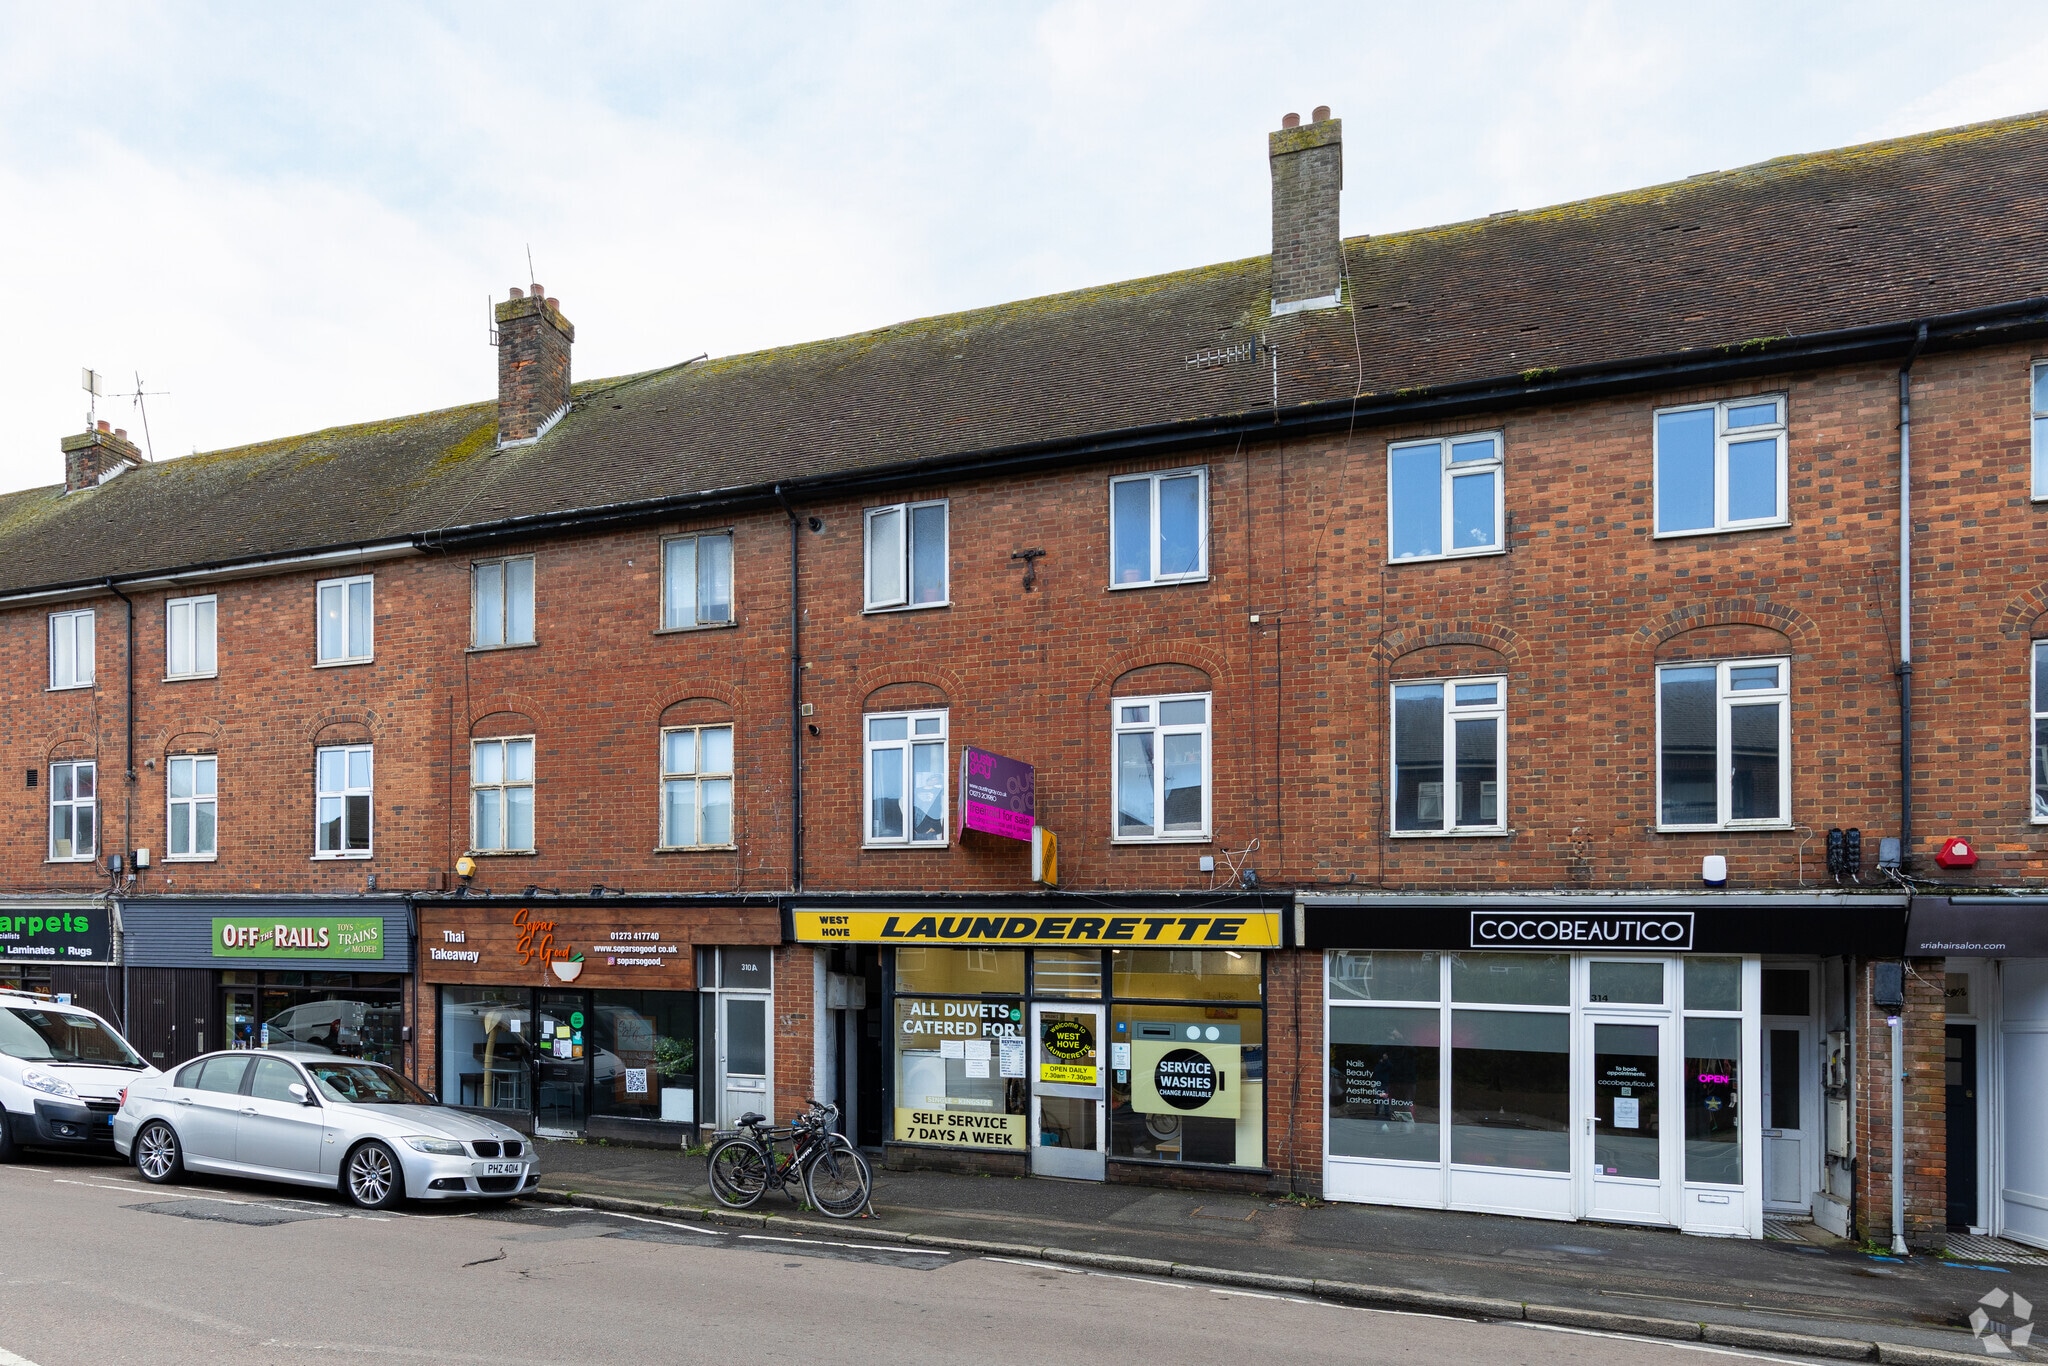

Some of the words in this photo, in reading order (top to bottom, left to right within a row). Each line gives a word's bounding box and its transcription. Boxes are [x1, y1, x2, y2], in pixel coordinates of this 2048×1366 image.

[970, 751, 997, 768] austin
[1003, 810, 1013, 821] for
[1014, 815, 1030, 826] sale
[512, 908, 558, 938] Sopar
[819, 916, 849, 925] WEST
[337, 923, 354, 931] TOYS
[822, 928, 850, 937] HOVE
[880, 916, 1248, 941] LAUNDERETTE
[1479, 920, 1684, 941] COCOBEAUTICO
[223, 924, 259, 947] OFF
[260, 930, 274, 942] THE
[274, 924, 329, 948] RAILS
[338, 927, 378, 945] TRAINS
[443, 930, 465, 943] Thai
[610, 932, 632, 940] 01273
[633, 932, 659, 941] 417740
[7, 945, 55, 955] Laminates
[67, 946, 92, 957] Rugs
[539, 933, 571, 968] Good
[1920, 941, 2006, 950] sriahairsalon.com
[430, 947, 479, 963] Takeaway
[1590, 994, 1608, 1002] 314
[910, 1002, 939, 1016] ALL
[944, 1003, 1009, 1018] DUVETS
[903, 1020, 977, 1036] CATERED
[982, 1023, 1016, 1037] FOR
[1050, 1022, 1078, 1033] welcome
[1079, 1026, 1086, 1034] to
[1057, 1032, 1080, 1040] WEST
[1056, 1040, 1080, 1048] HOVE
[1045, 1042, 1091, 1060] LAUNDERETTE
[1050, 1065, 1068, 1073] OPEN
[1160, 1061, 1211, 1074] SERVICE
[1346, 1069, 1374, 1078] Beauty
[1160, 1076, 1211, 1089] WASHES
[1346, 1078, 1382, 1087] Massage
[1698, 1074, 1729, 1084] OPEN
[1182, 1090, 1212, 1098] AVAILABLE
[1346, 1087, 1385, 1096] Aesthetics
[927, 1096, 952, 1104] SINGLE
[1346, 1096, 1371, 1104] Lashes
[1373, 1097, 1389, 1105] and
[1391, 1098, 1414, 1106] Brows
[912, 1113, 944, 1124] SELF
[948, 1114, 1007, 1129] SERVICE
[907, 1128, 915, 1138] 7
[920, 1128, 955, 1141] DAYS
[959, 1130, 969, 1142] A
[972, 1132, 1013, 1145] WEEK
[487, 1164, 503, 1173] PHZ
[504, 1163, 518, 1173] 4014
